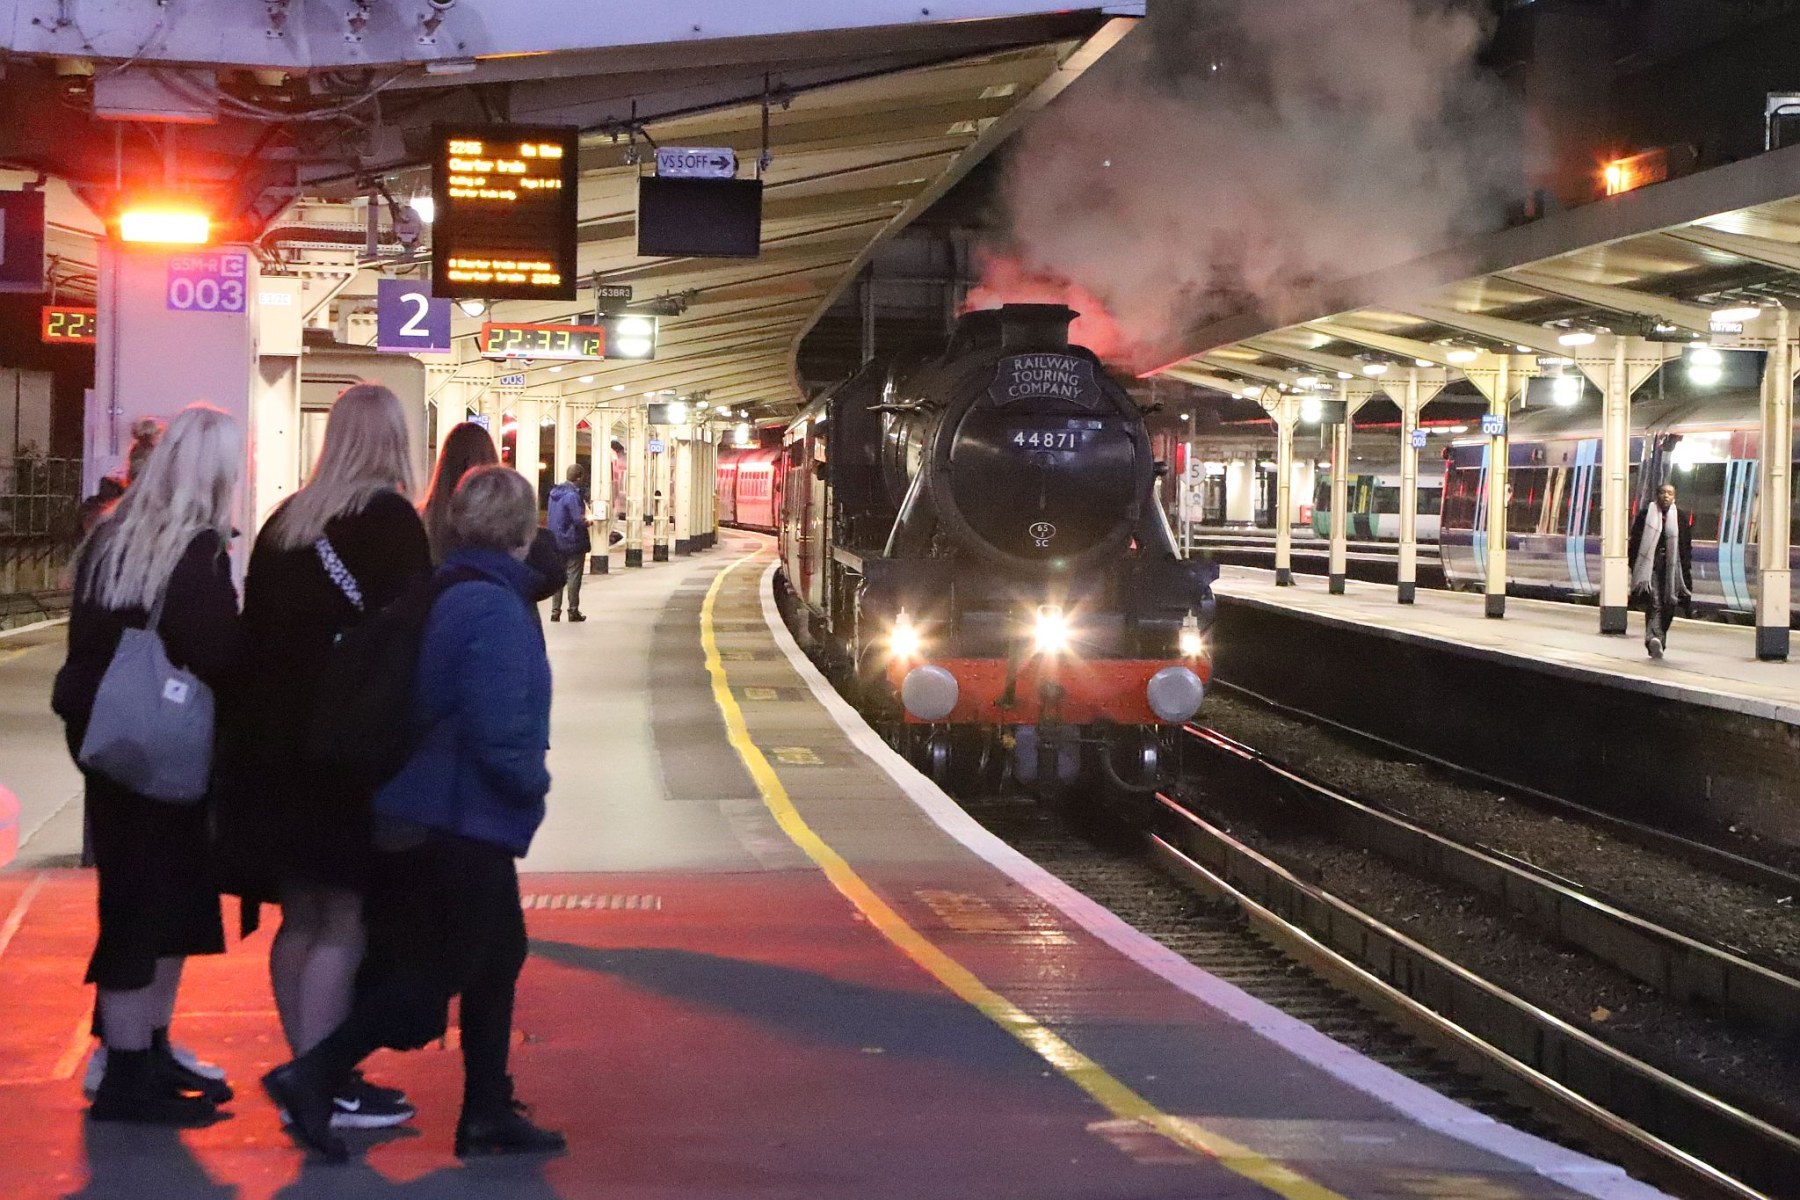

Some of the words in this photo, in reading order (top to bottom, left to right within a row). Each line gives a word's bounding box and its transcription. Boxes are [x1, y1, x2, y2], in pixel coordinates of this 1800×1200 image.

[449, 158, 494, 171] Charter
[497, 159, 526, 173] train
[449, 187, 479, 197] Charter
[449, 270, 494, 281] Charter
[170, 278, 244, 310] 003
[399, 292, 430, 337] 2
[487, 329, 570, 352] 22:33
[1014, 357, 1078, 371] RAILWAY
[1012, 370, 1080, 386] TOURING
[1008, 382, 1083, 398] COMPANY
[1483, 423, 1503, 434] 007
[1013, 431, 1075, 448] 44871
[1191, 464, 1200, 478] 5
